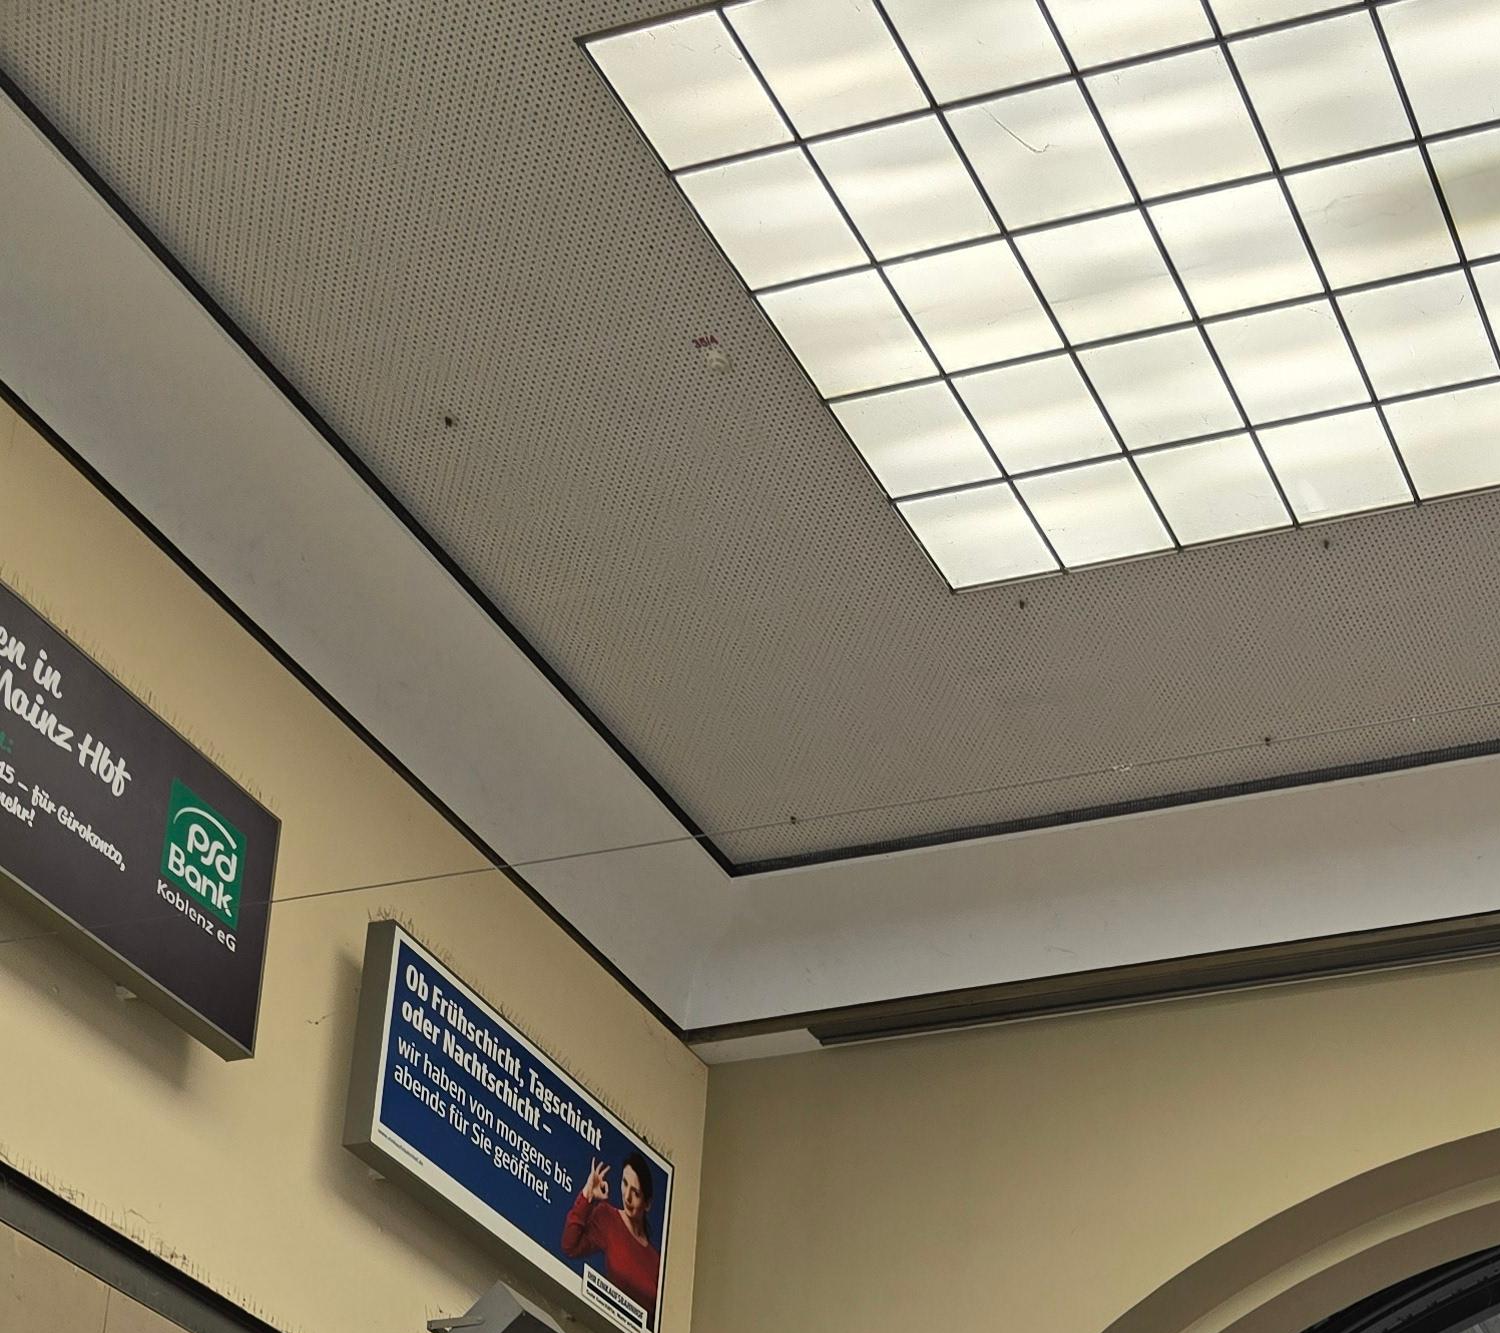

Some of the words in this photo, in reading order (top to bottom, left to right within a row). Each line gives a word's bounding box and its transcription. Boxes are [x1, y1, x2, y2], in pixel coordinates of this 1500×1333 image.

[33, 648, 63, 699] in
[77, 732, 132, 798] Hbf
[31, 784, 57, 815] für
[57, 804, 126, 872] Girokonto,
[187, 822, 238, 882] psd
[156, 879, 214, 936] Koblenz
[216, 929, 237, 953] eG
[167, 842, 234, 918] Bank
[402, 1000, 439, 1046] oder
[442, 1032, 541, 1131] Nachtschicht
[405, 963, 429, 1003] Ob
[431, 984, 526, 1088] Frühschicht,
[528, 1066, 602, 1151] Tagschicht
[394, 1064, 446, 1120] abends
[449, 1101, 469, 1138] für
[471, 1123, 493, 1157] Sie
[494, 1145, 552, 1204] geöffnet.
[397, 1036, 421, 1068] wir
[423, 1051, 466, 1106] haben
[469, 1094, 494, 1128] von
[496, 1119, 552, 1176] morgens
[554, 1159, 573, 1192] bis
